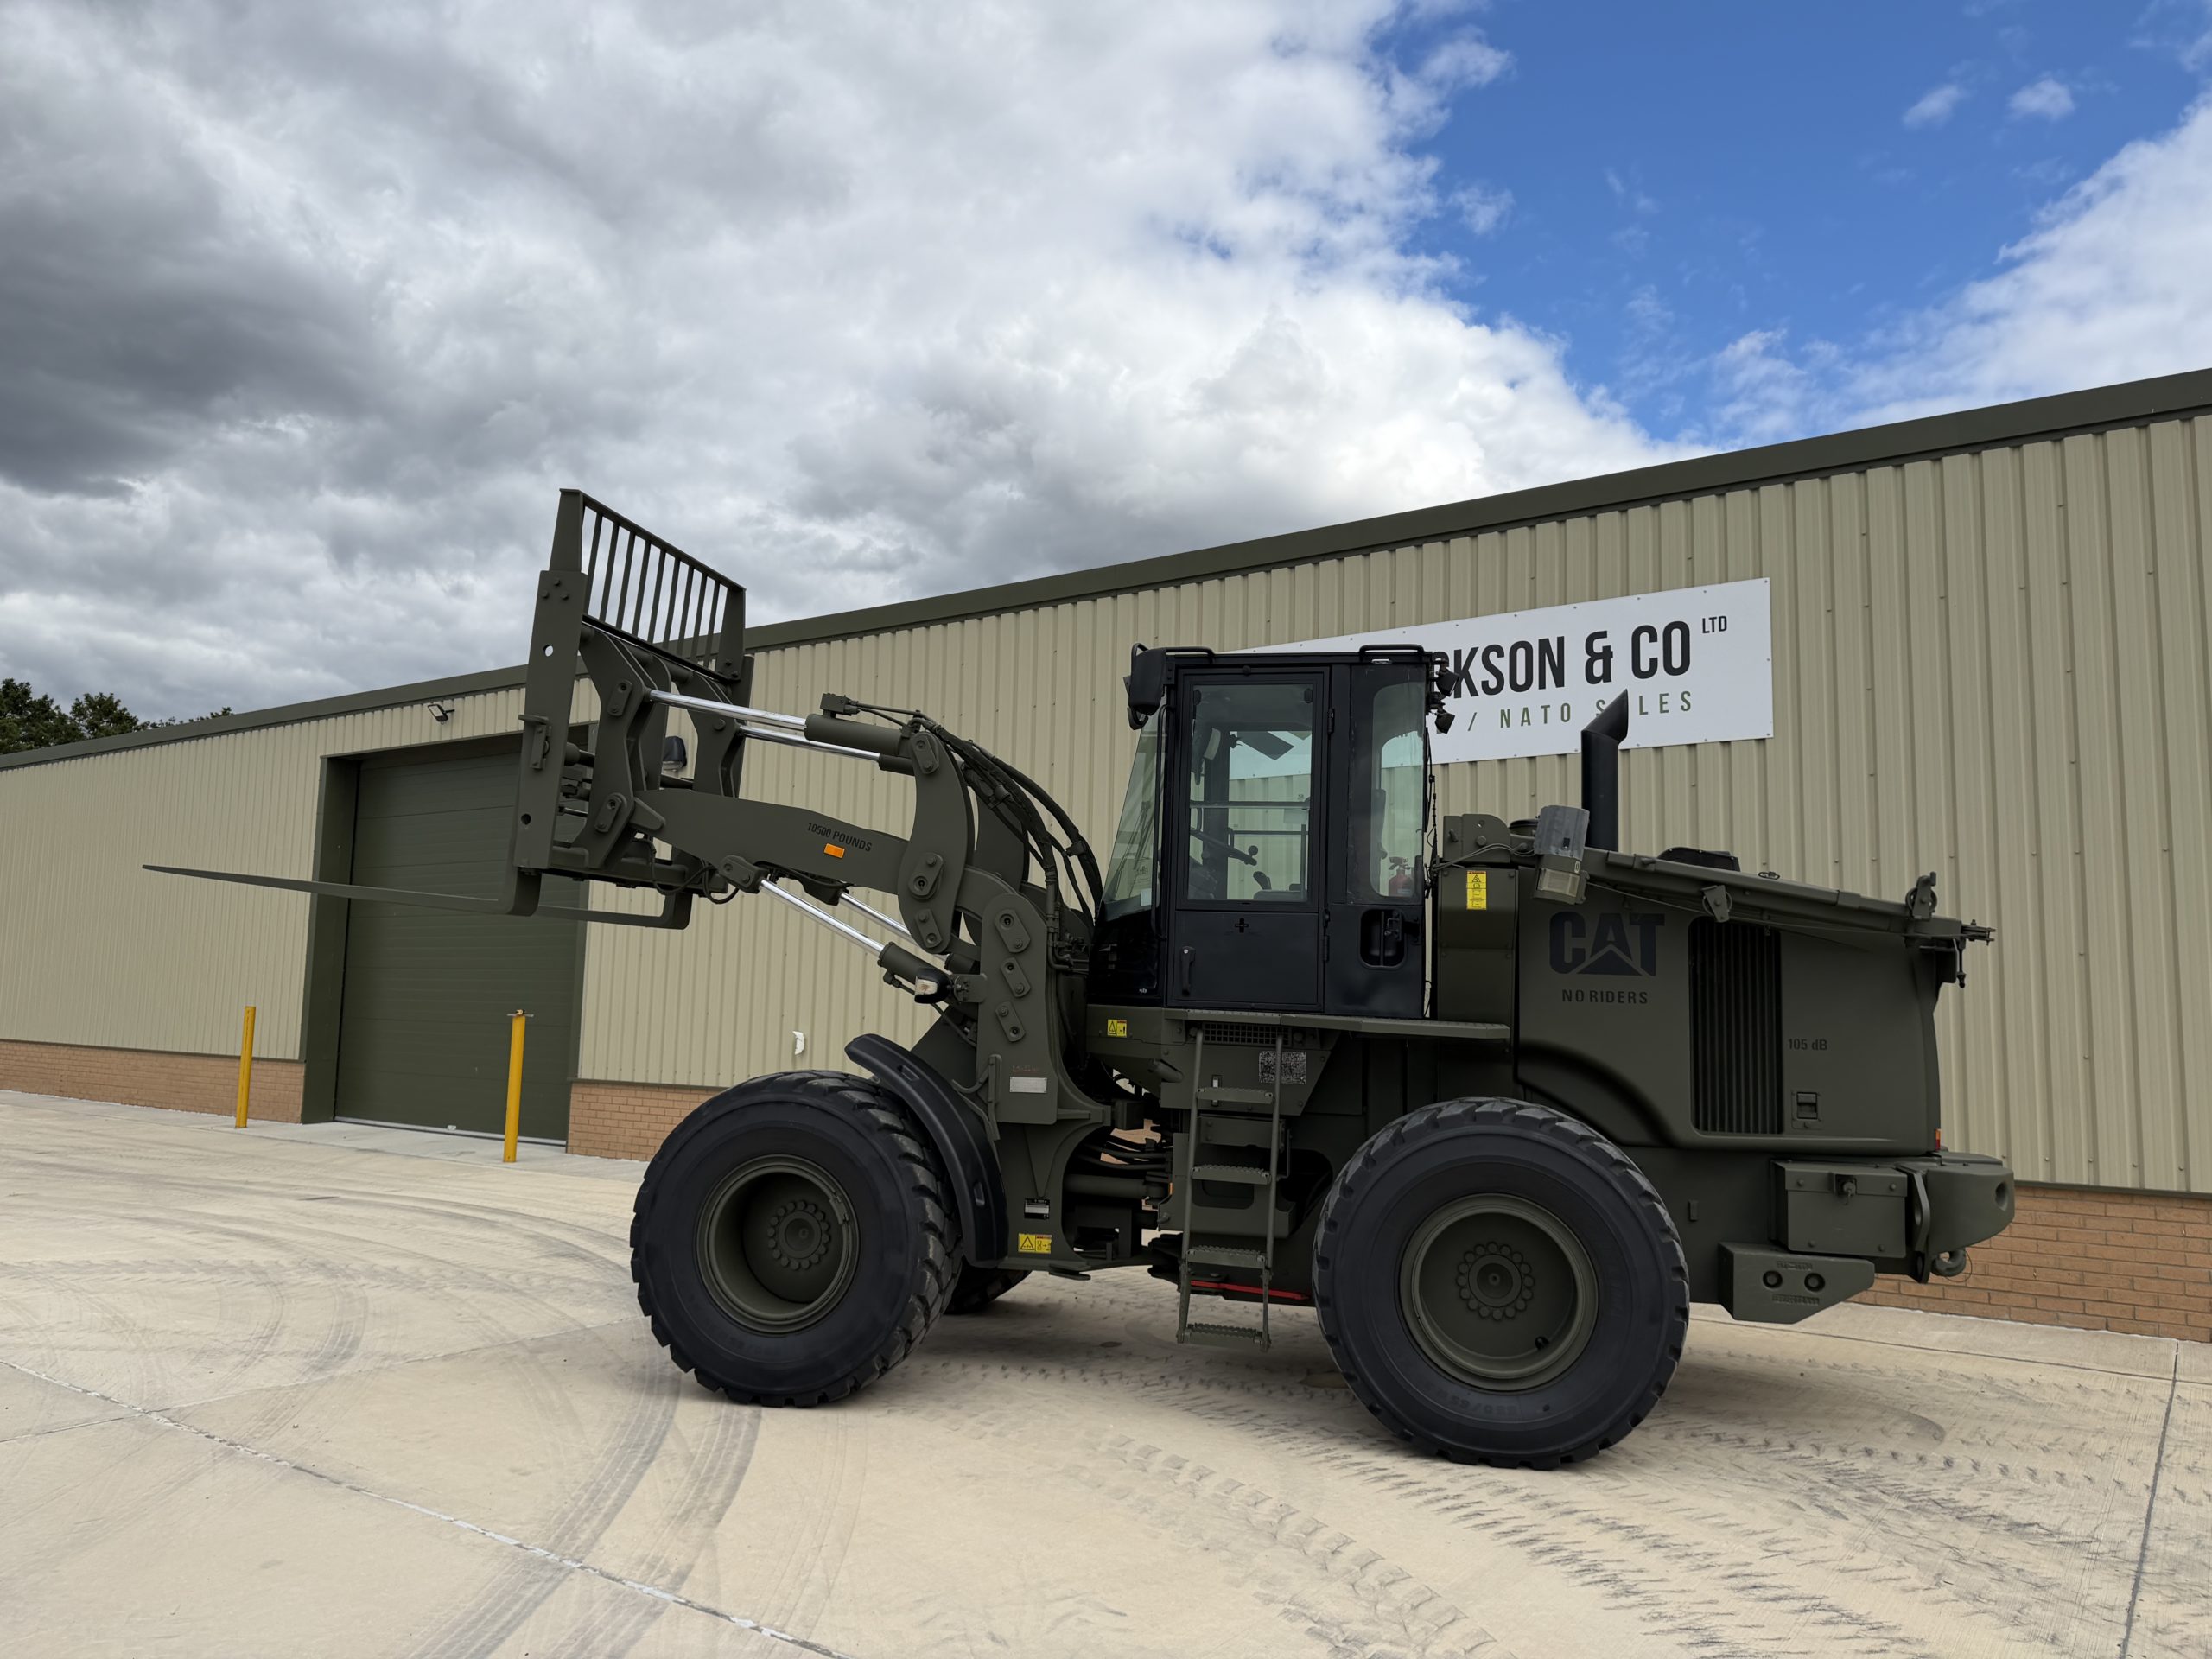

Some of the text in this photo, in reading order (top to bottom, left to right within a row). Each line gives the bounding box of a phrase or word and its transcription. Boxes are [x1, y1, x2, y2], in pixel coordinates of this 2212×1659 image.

[1432, 614, 1727, 699] KSON & CO LTD
[1500, 702, 1571, 729] NATO
[1595, 690, 1691, 717] SLES
[806, 822, 873, 853] 10500 POUNDS
[1548, 911, 1666, 977] CAT
[1561, 989, 1649, 1005] NO RIDERS
[1788, 1038, 1828, 1052] 105 dB
